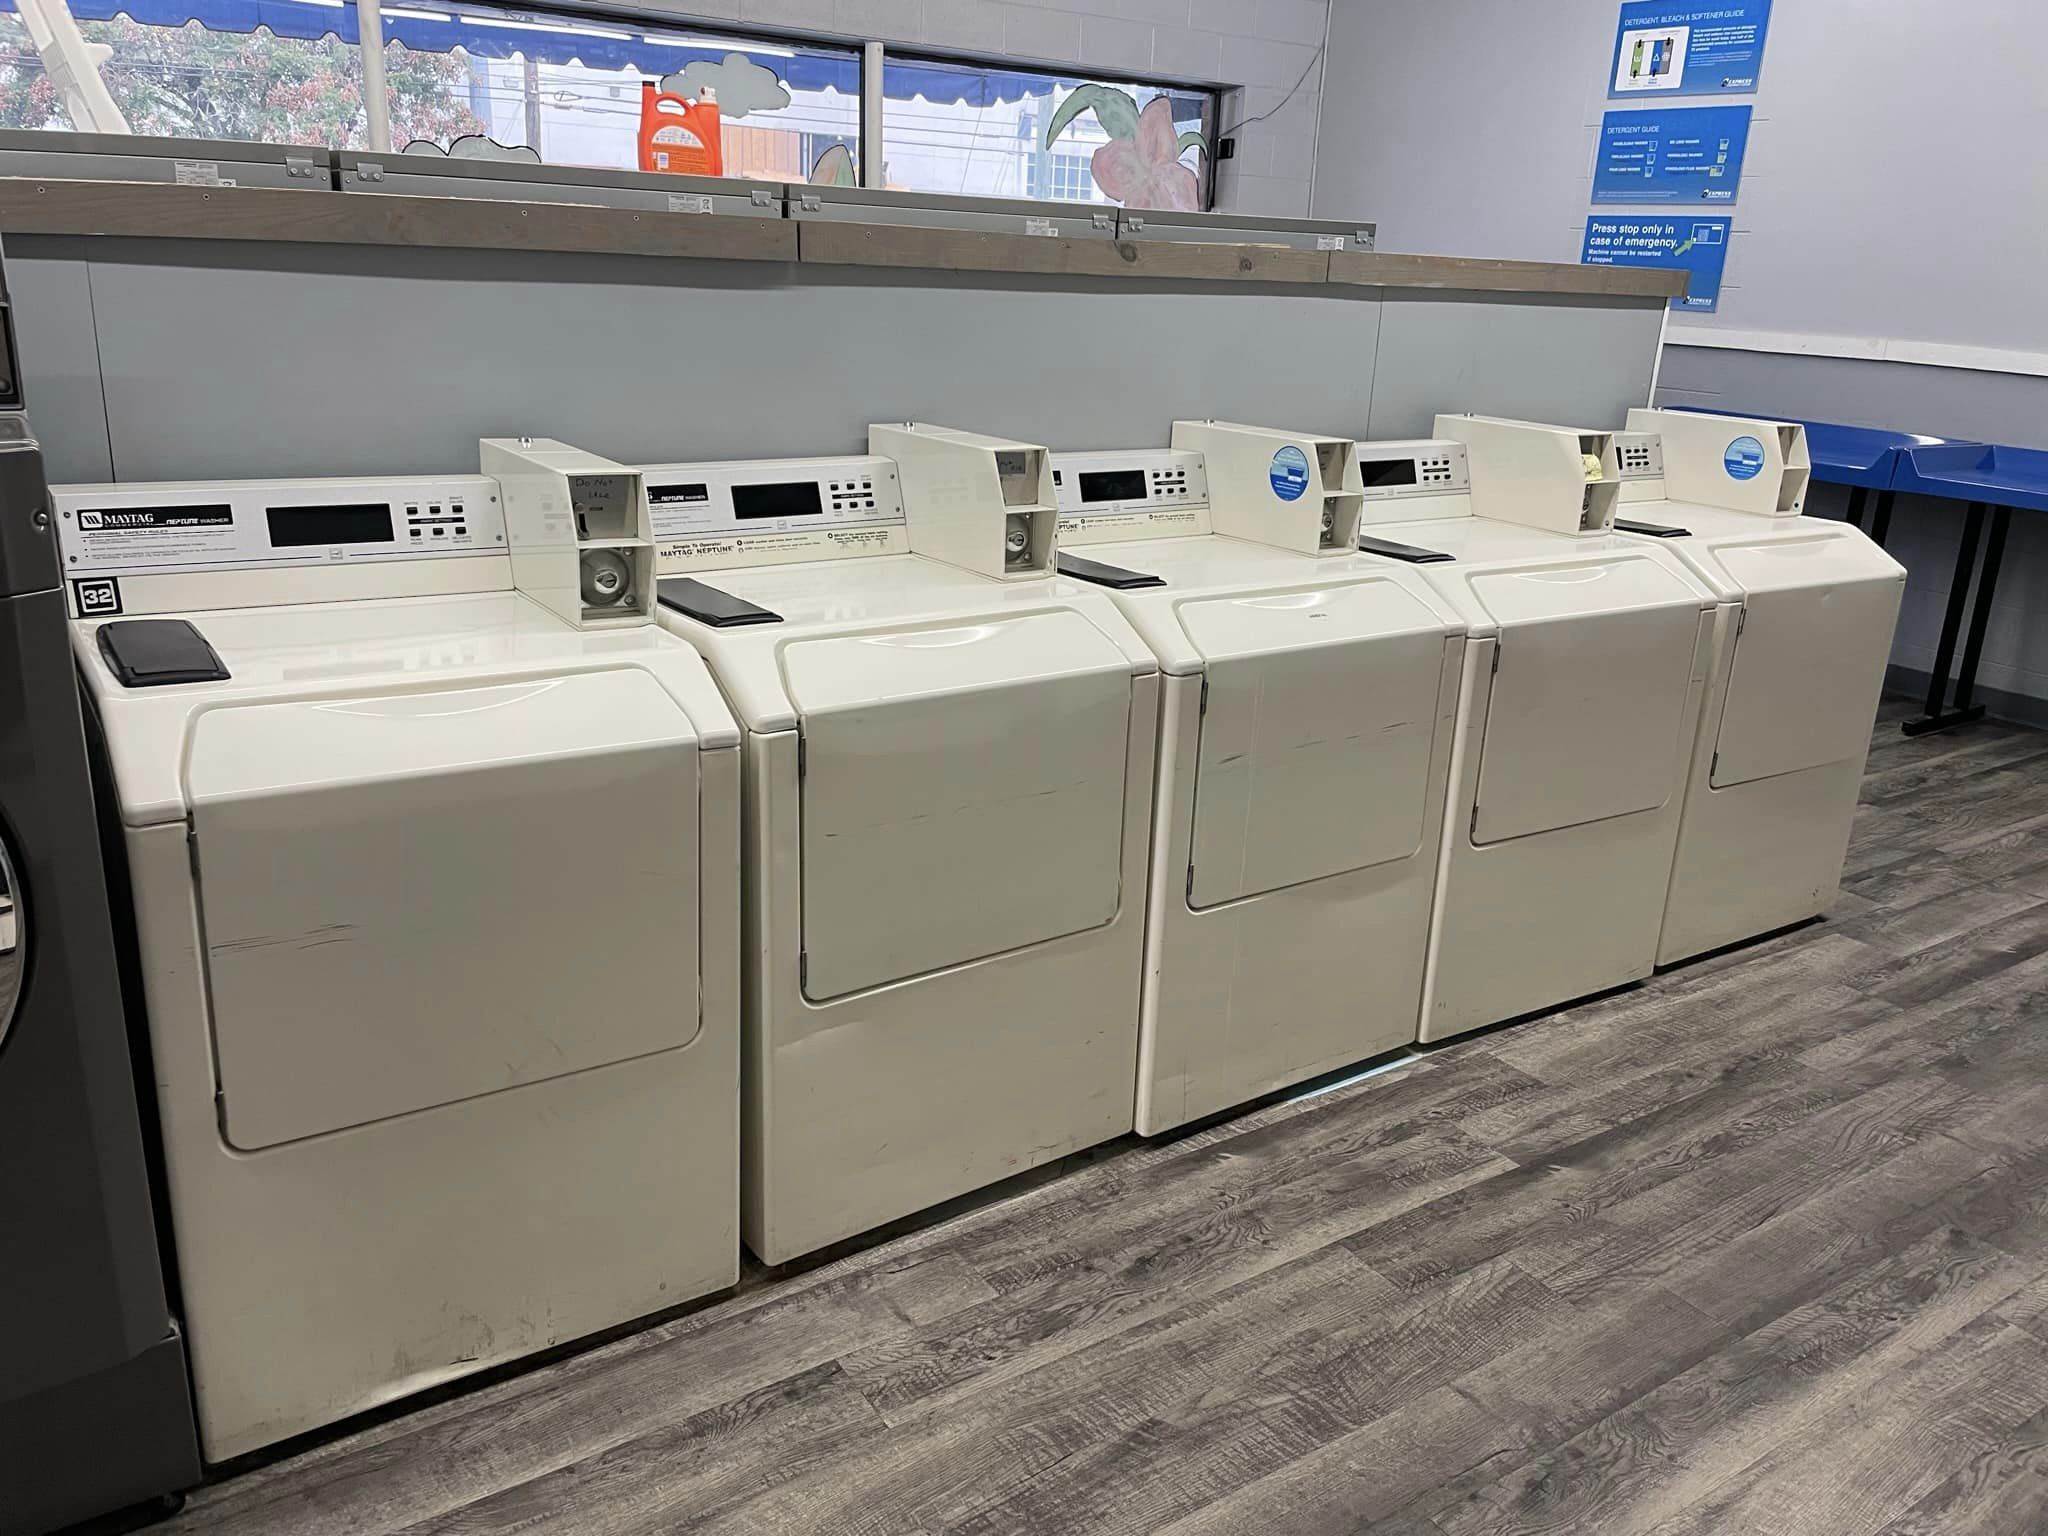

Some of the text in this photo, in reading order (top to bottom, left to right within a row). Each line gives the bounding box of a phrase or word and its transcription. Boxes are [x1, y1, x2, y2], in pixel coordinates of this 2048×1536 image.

[1724, 9, 1745, 18] GUIDE
[1607, 126, 1641, 134] DETERGENT
[1592, 223, 1674, 236] Press stop only in
[1590, 236, 1678, 249] case of emergency.
[104, 513, 154, 525] MAYTAG
[84, 588, 113, 605] 32
